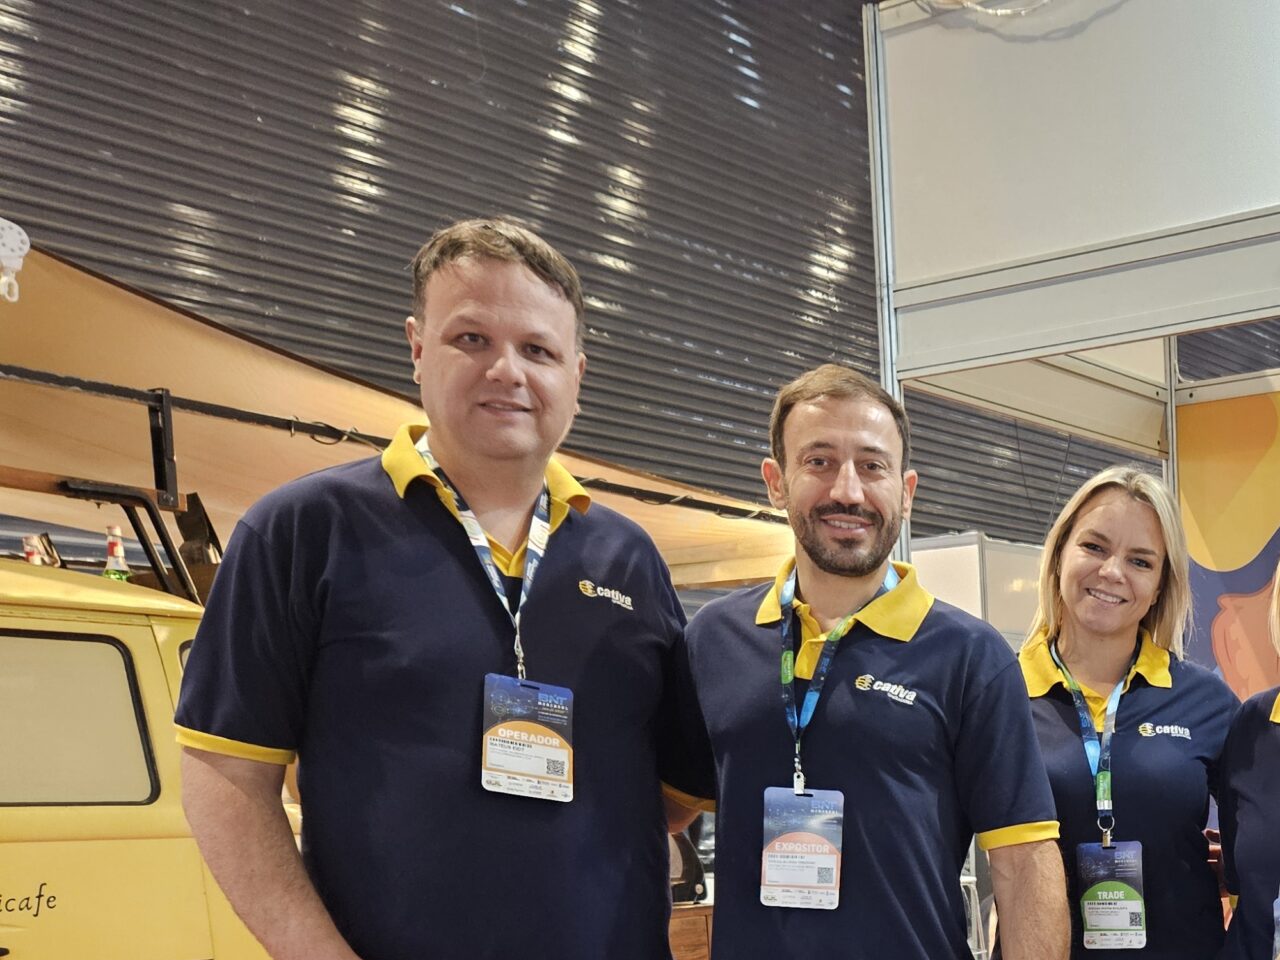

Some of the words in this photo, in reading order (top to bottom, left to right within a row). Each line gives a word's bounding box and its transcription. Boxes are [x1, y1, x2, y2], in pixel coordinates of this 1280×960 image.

[498, 728, 561, 748] OPERADOR
[775, 842, 830, 854] EXPOSITOR
[1097, 890, 1125, 900] TRADE
